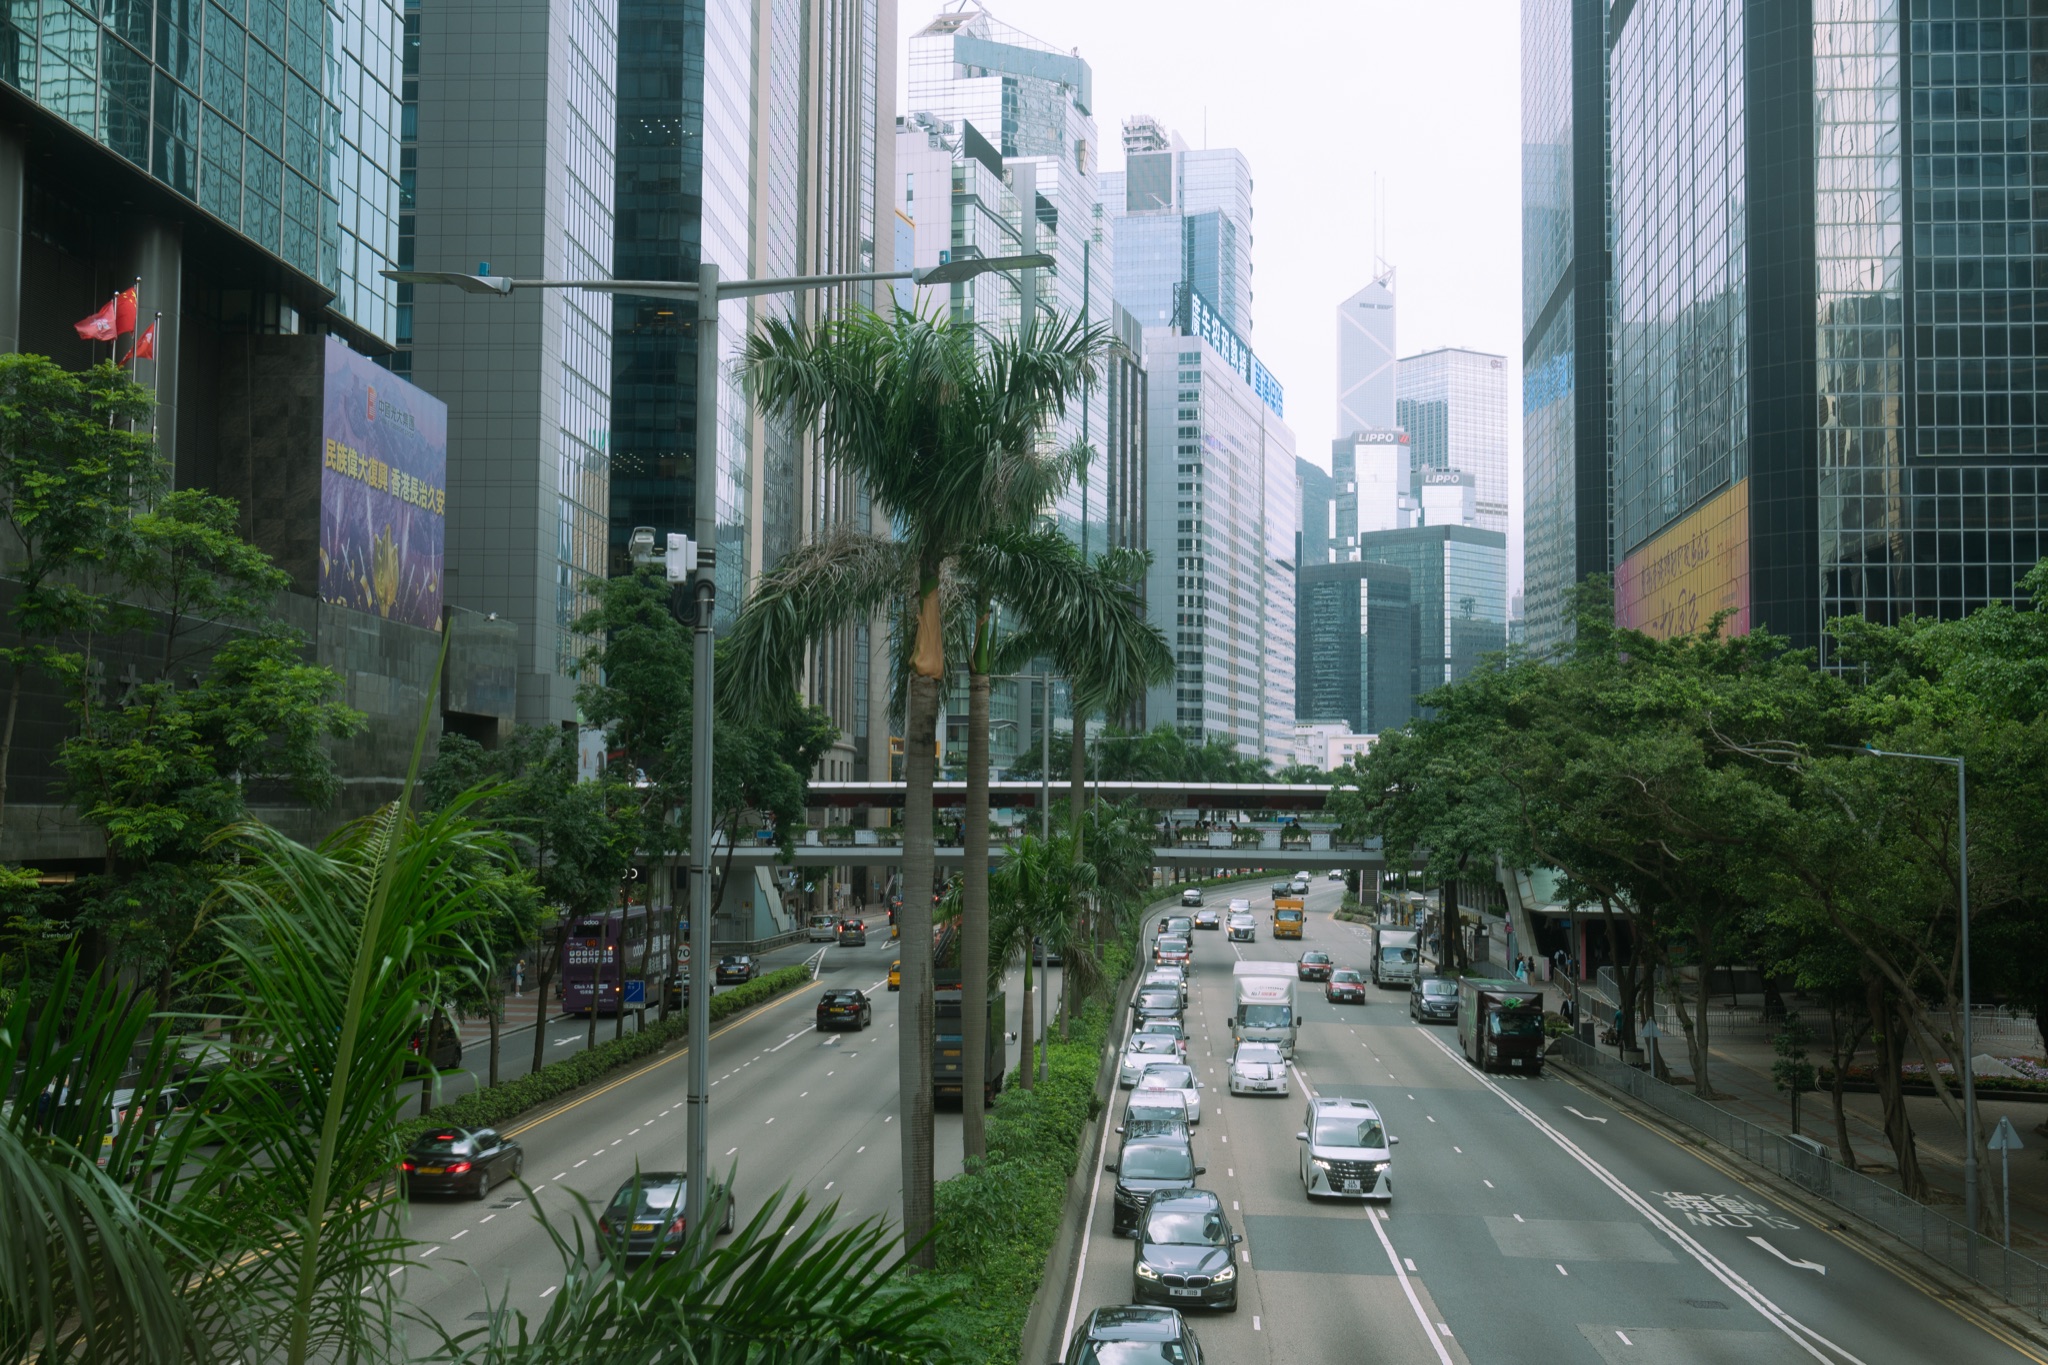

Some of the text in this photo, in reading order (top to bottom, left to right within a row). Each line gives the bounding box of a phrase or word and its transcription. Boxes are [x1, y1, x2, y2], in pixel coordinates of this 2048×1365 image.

[378, 398, 415, 432] 中國光大集團
[1358, 433, 1395, 443] LIPPO
[325, 438, 445, 516] 民族偉大復興 香港長治久安
[1425, 474, 1460, 484] LIPPO
[632, 942, 644, 958] odoo
[678, 949, 690, 958] 70
[1684, 1212, 1801, 1230] SLOW
